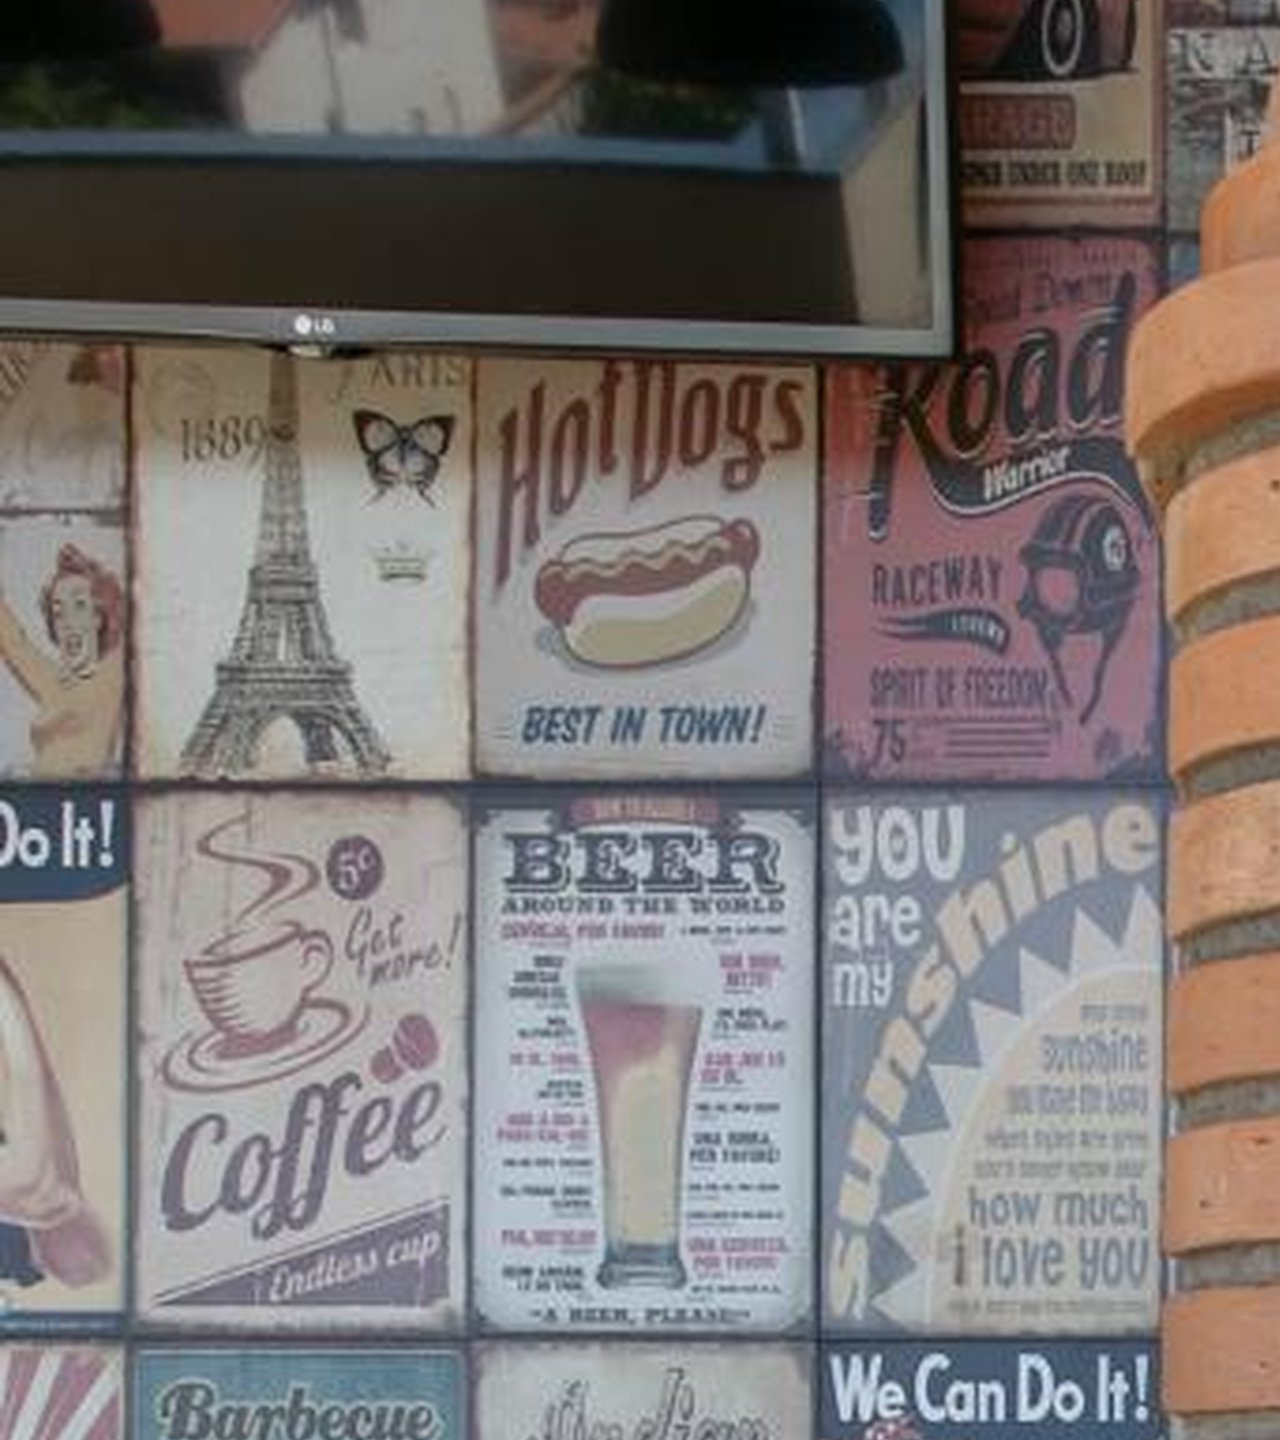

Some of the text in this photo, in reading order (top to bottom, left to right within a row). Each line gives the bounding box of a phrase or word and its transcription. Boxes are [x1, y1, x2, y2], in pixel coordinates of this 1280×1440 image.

[870, 555, 1002, 606] RACEWAY
[936, 667, 957, 708] OF
[521, 704, 767, 744] BEST IN TOWN!
[872, 718, 906, 763] 75
[61, 799, 115, 868] It!
[830, 805, 965, 885] you
[502, 831, 787, 894] BEER
[501, 896, 786, 915] AROUND THE WORLD
[830, 893, 922, 950] are
[345, 908, 404, 976] Get
[832, 961, 894, 1008] my
[160, 1071, 448, 1240] Coffee
[968, 1184, 1149, 1230] how much
[267, 1244, 378, 1303] Endless
[386, 1228, 442, 1270] cup
[983, 1236, 1066, 1290] love
[1078, 1236, 1149, 1291] you
[829, 1353, 1151, 1423] We Can Do It!
